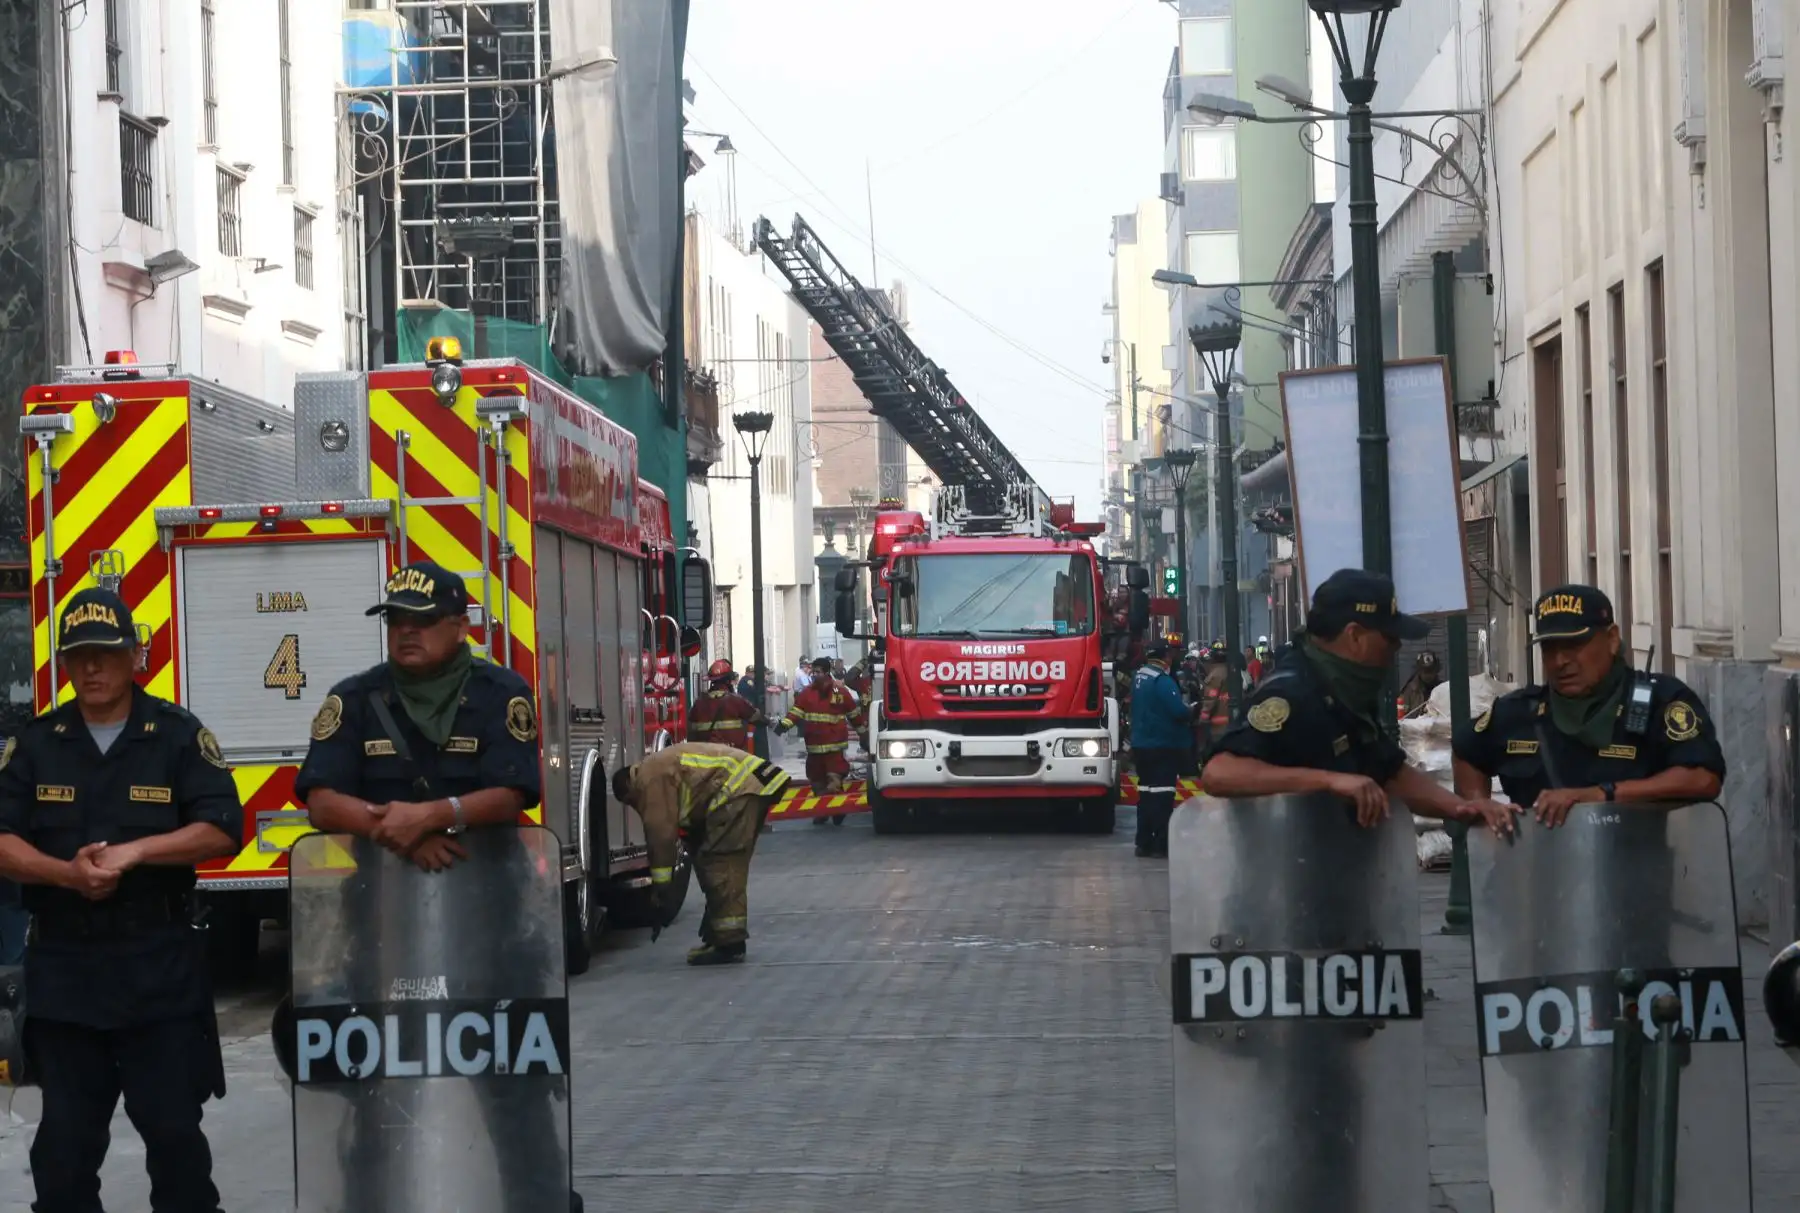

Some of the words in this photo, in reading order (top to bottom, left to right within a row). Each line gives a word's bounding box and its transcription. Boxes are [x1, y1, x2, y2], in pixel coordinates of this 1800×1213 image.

[386, 568, 435, 598] POLICIA
[256, 591, 308, 613] LIMA
[1538, 594, 1584, 620] POLICIA
[64, 602, 119, 634] POLICIA
[960, 644, 1026, 655] MAGIRUS
[264, 634, 307, 700] 4
[960, 684, 1028, 697] IVECO
[1190, 954, 1411, 1020] POLICIA
